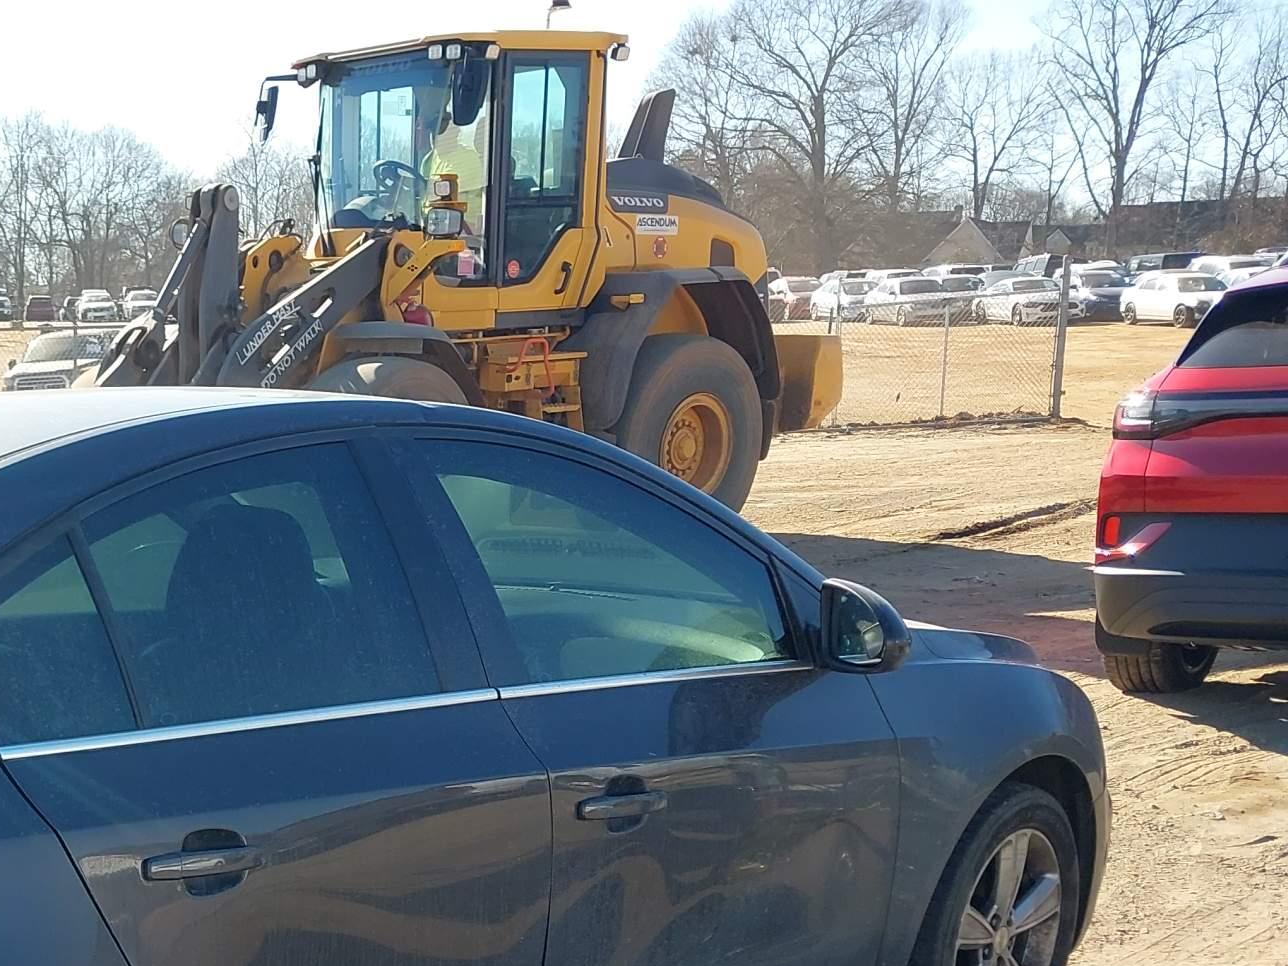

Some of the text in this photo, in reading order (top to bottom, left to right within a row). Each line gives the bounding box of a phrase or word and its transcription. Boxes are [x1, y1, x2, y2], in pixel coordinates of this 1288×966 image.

[611, 196, 664, 207] VOLVO
[637, 217, 677, 227] ASCENDUM
[243, 300, 296, 358] UNDER MAST
[277, 347, 296, 375] NOT
